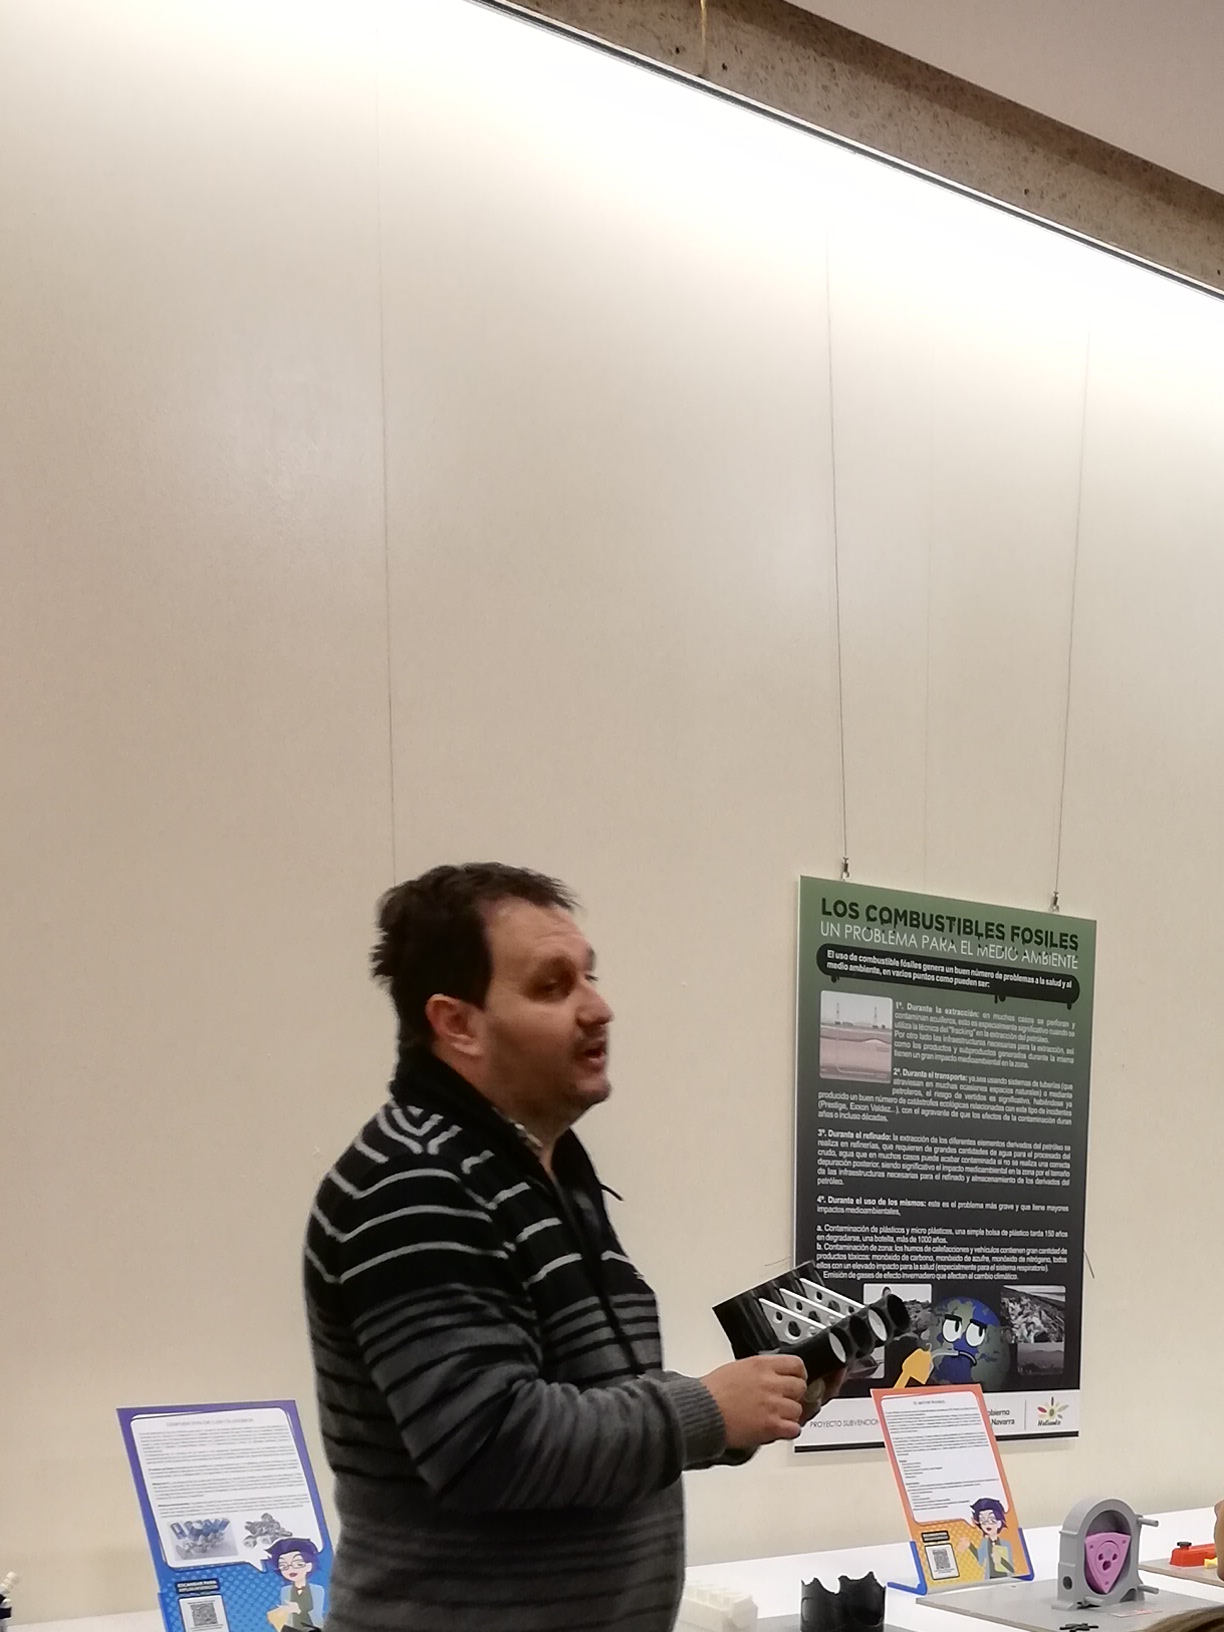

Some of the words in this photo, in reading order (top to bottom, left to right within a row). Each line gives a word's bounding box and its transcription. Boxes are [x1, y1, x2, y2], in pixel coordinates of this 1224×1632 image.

[821, 897, 859, 922] LOS
[865, 903, 1005, 942] COMBUSTIBLES
[1010, 925, 1078, 952] FOSILES
[820, 920, 840, 938] UN
[844, 923, 917, 948] PROBLEMA
[921, 934, 956, 953] PARA
[960, 939, 973, 955] EL
[976, 941, 1017, 961] MEDIO
[1021, 948, 1078, 969] AMBIENTE
[826, 960, 847, 970] medio
[849, 962, 881, 976] ambiente,
[892, 968, 911, 978] varios
[912, 970, 934, 982] puntos
[935, 975, 952, 983] como
[954, 975, 977, 988] pueden
[827, 949, 834, 958] El
[835, 952, 847, 960] uso
[849, 952, 857, 961] de
[858, 953, 899, 966] combustible
[900, 959, 921, 969] fósiles
[923, 963, 944, 974] genera
[954, 965, 969, 975] buen
[971, 967, 994, 978] número
[995, 971, 1002, 979] de
[1003, 972, 1034, 985] problemas
[1039, 976, 1044, 984] la
[1045, 977, 1061, 986] salud
[1061, 981, 1065, 989] y
[1066, 980, 1071, 988] al
[810, 1419, 842, 1428] PROYECTO
[987, 1408, 1010, 1416] obierno
[991, 1418, 1015, 1426] Navarra
